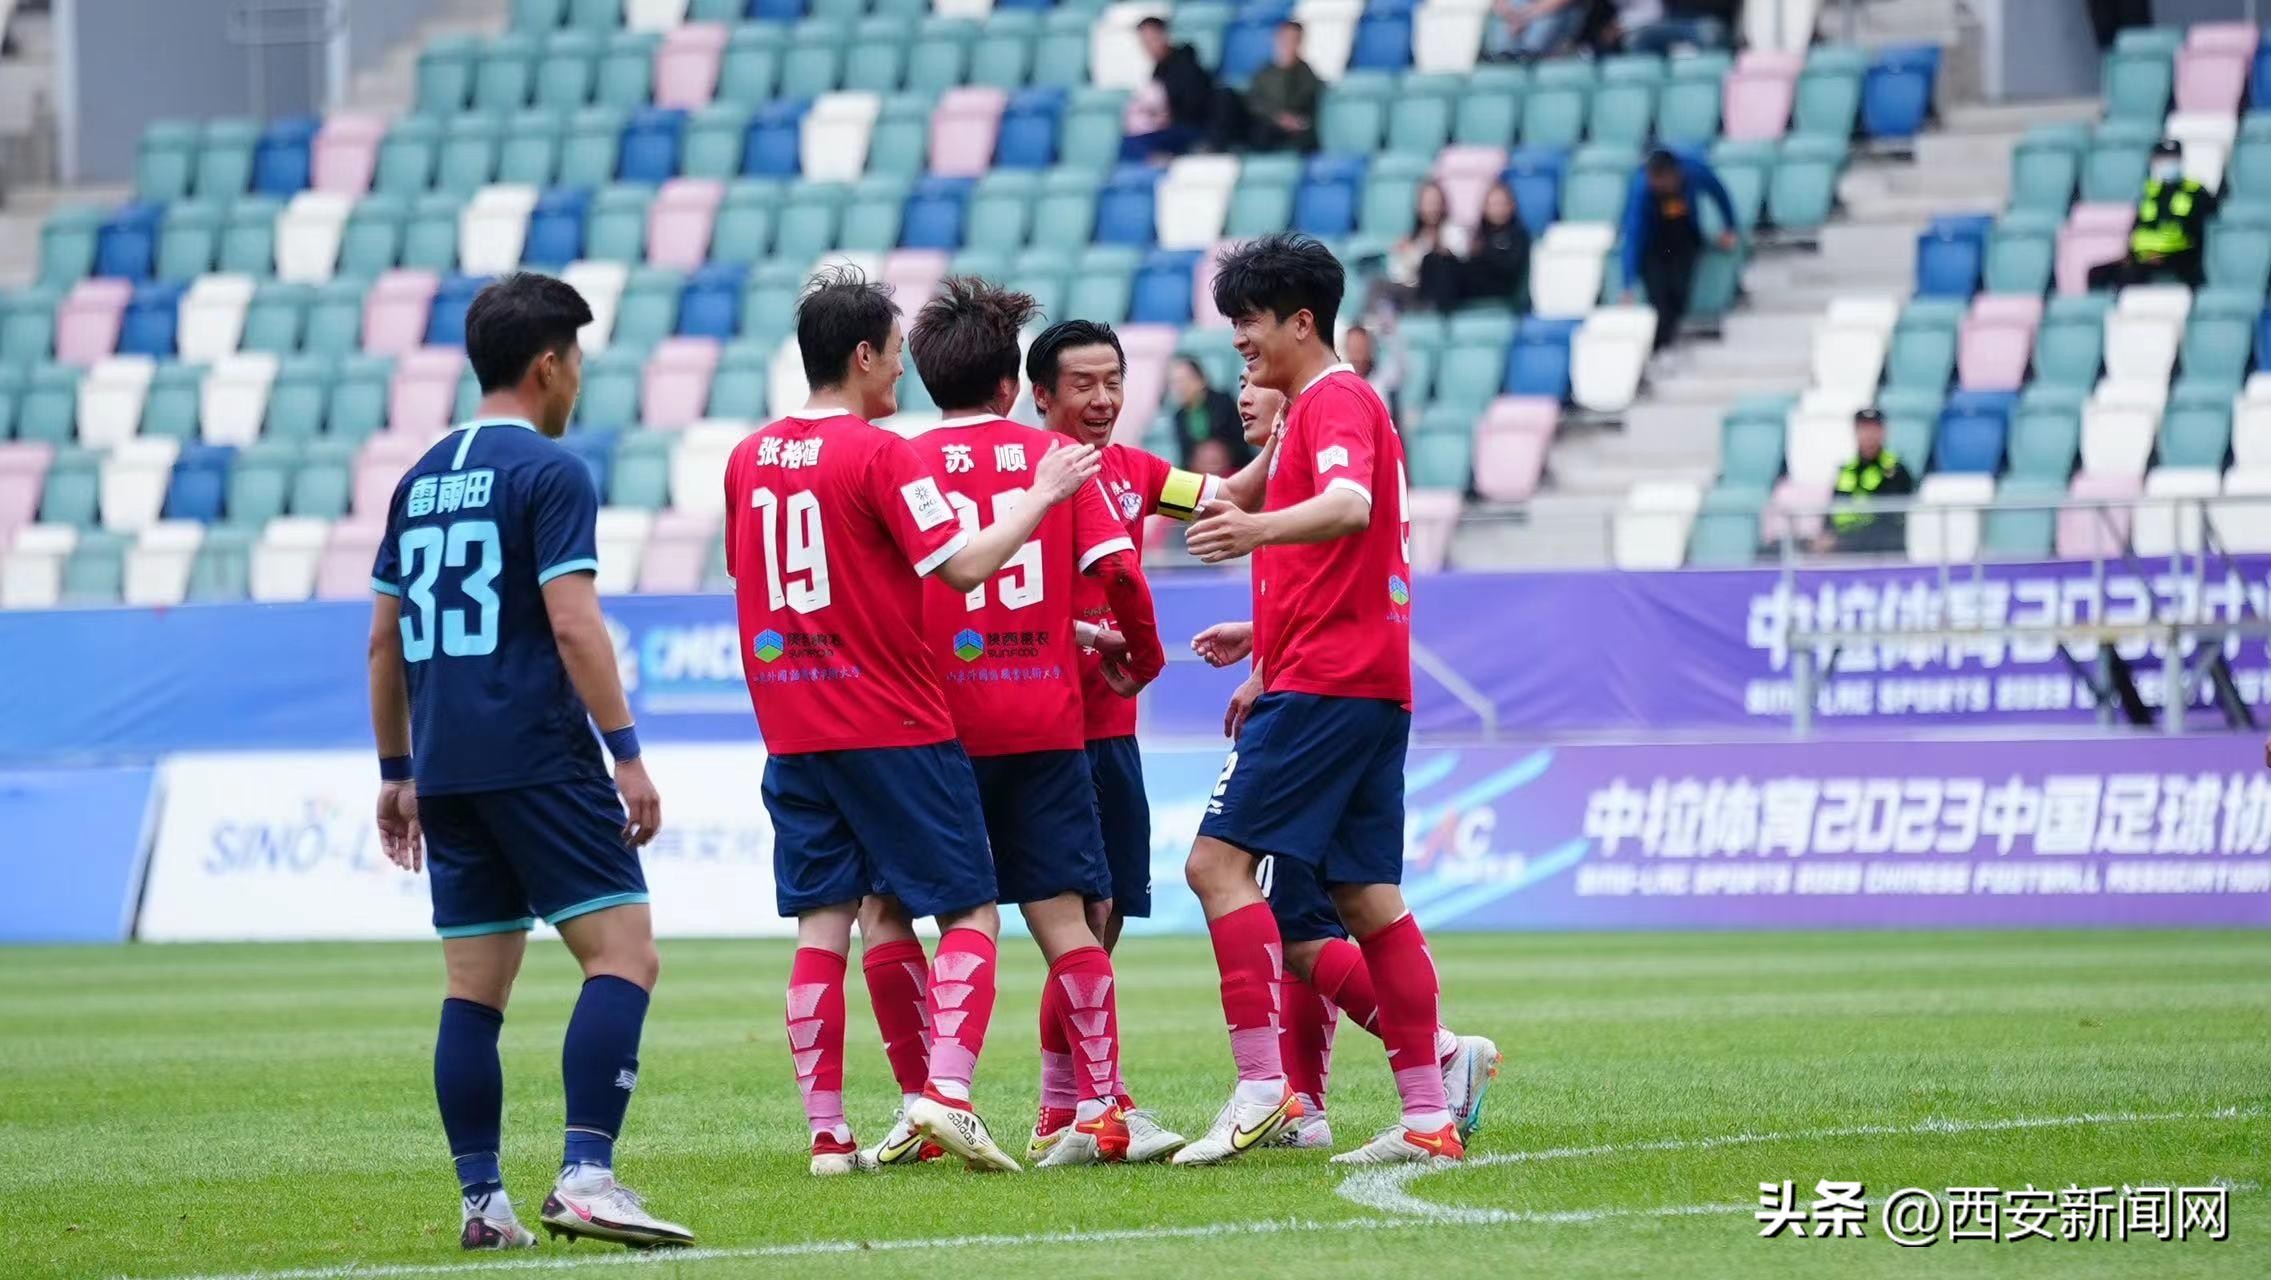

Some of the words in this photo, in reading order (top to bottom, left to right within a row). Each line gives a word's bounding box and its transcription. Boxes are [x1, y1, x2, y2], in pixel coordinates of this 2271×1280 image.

[408, 470, 495, 518] 雷雨田
[751, 486, 831, 614] 19
[398, 520, 502, 663] 33
[1583, 776, 2271, 857] 中拉体育2023中国足球协
[947, 1112, 977, 1145] adidas
